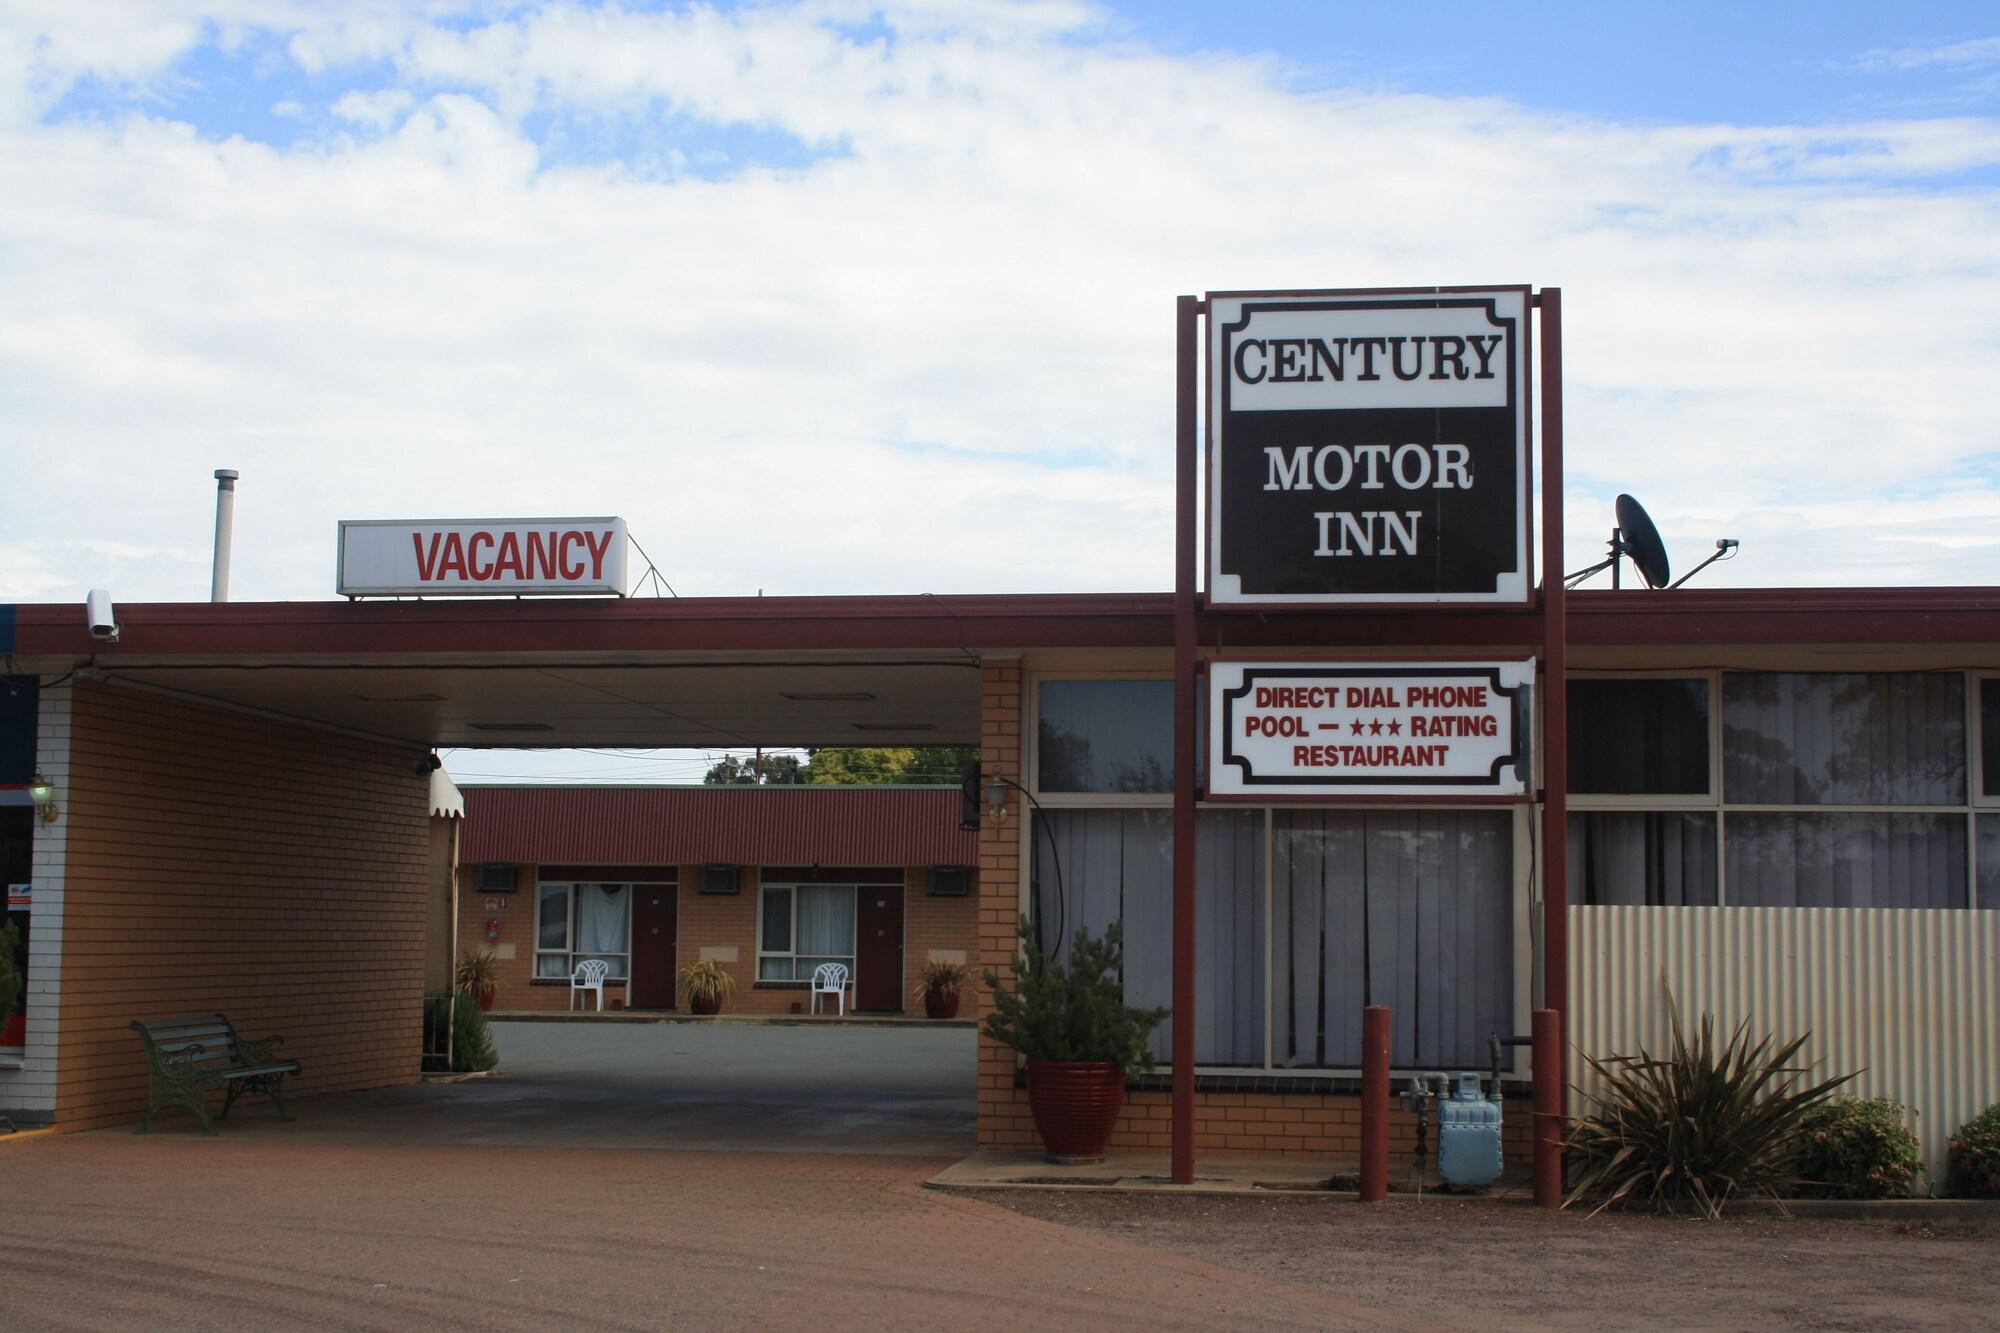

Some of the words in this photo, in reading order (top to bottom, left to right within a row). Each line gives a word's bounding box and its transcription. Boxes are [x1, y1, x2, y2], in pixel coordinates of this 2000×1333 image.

[1234, 335, 1502, 384] CENTURY
[1264, 444, 1473, 491] MOTOR
[413, 531, 613, 581] VACANCY
[1314, 511, 1421, 556] INN
[1256, 687, 1339, 708] DIRECT
[1347, 686, 1400, 708] DIAL
[1407, 686, 1487, 708] PHONE
[1245, 715, 1309, 738] POOL
[1411, 715, 1498, 737] RATING
[1293, 745, 1449, 767] RESTAURANT
